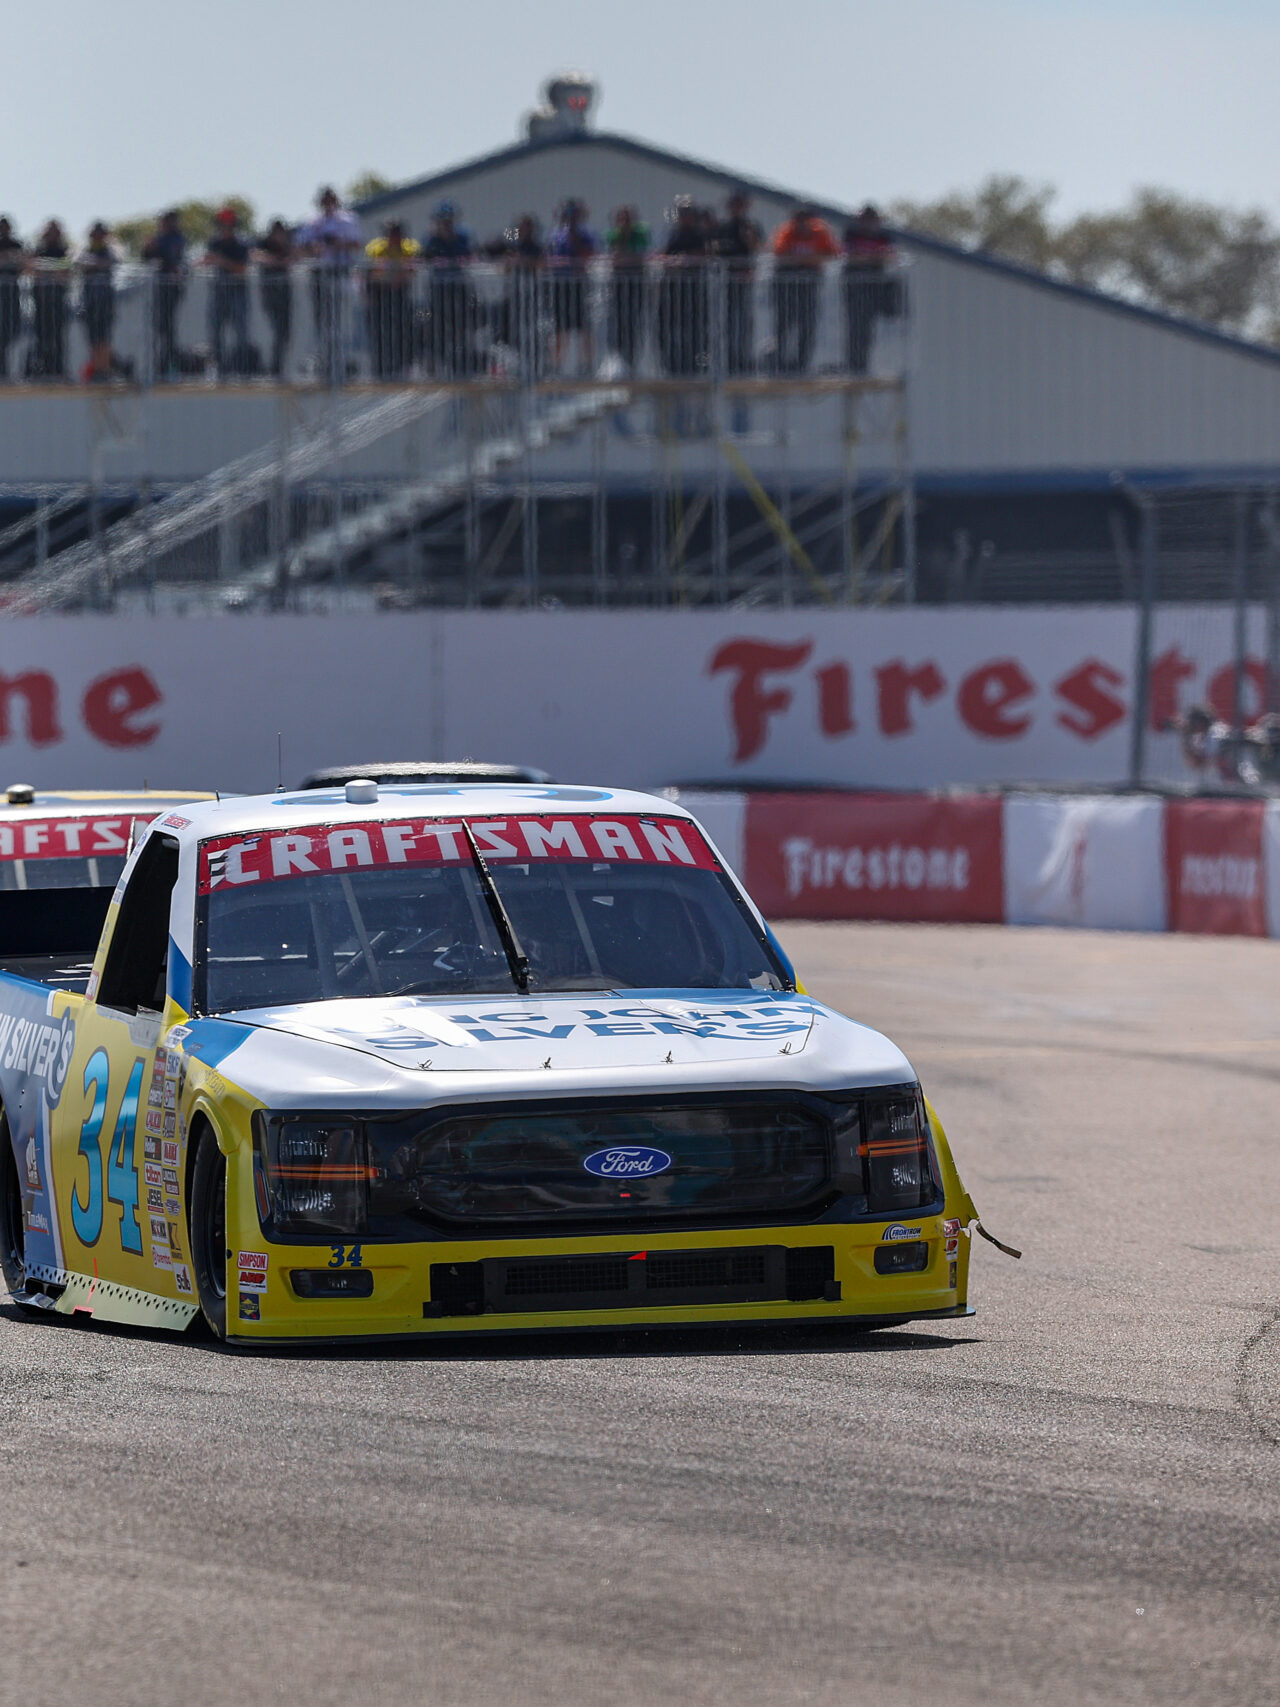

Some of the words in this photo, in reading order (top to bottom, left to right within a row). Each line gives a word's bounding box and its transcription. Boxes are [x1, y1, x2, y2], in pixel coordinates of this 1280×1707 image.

[224, 821, 697, 885] CRAFTSMAN
[781, 837, 971, 897] Firestone
[4, 1016, 73, 1100] SILVER'S
[71, 1046, 146, 1257] 34
[601, 1151, 654, 1173] Ford
[240, 1253, 266, 1268] SIMPSON
[328, 1244, 363, 1268] 34
[240, 1272, 266, 1283] ARP
